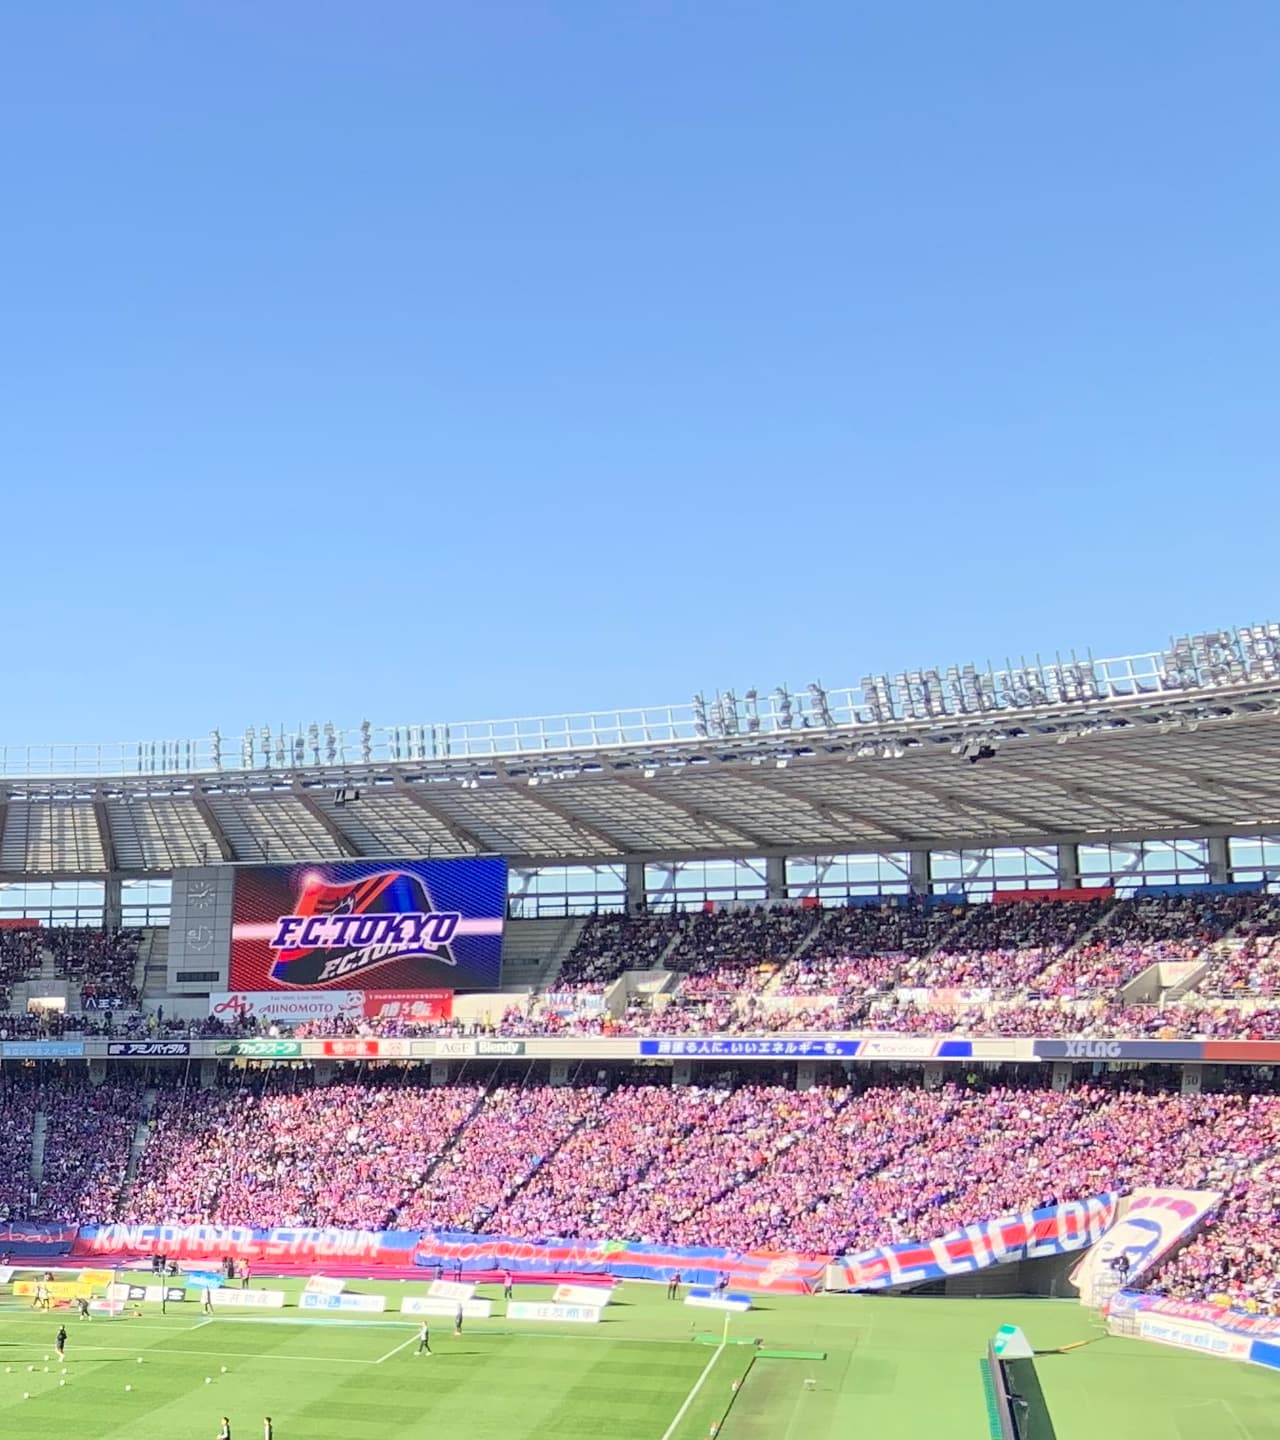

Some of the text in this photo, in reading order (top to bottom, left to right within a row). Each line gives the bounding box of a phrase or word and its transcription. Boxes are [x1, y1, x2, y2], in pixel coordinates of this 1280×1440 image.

[259, 1003, 333, 1013] AJINOMOTO
[478, 1042, 519, 1054] Blendy
[1064, 1042, 1122, 1057] XFLAG
[1184, 1075, 1198, 1085] 50
[94, 1225, 156, 1249] KING
[266, 1228, 382, 1258] STADIUM
